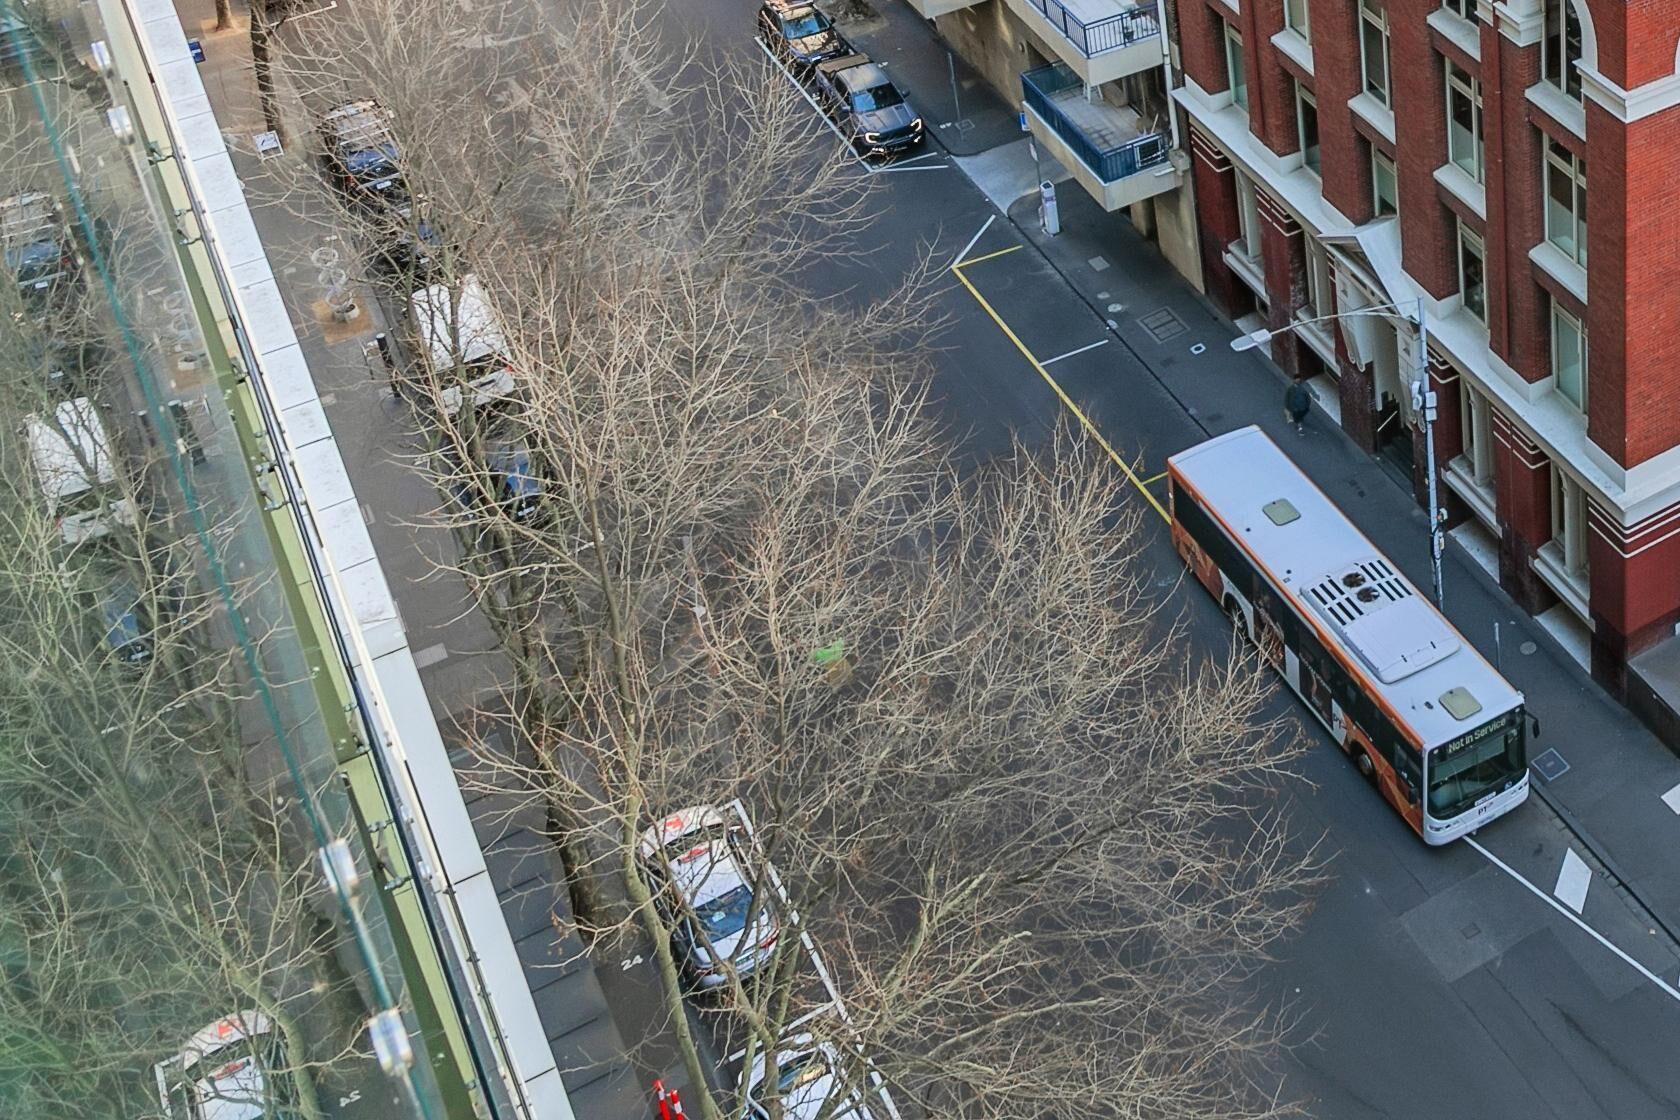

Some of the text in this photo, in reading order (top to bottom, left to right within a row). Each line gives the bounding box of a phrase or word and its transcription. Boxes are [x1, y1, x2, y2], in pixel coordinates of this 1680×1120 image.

[1448, 741, 1463, 754] Not
[1475, 718, 1507, 740] Service
[621, 954, 643, 971] 24
